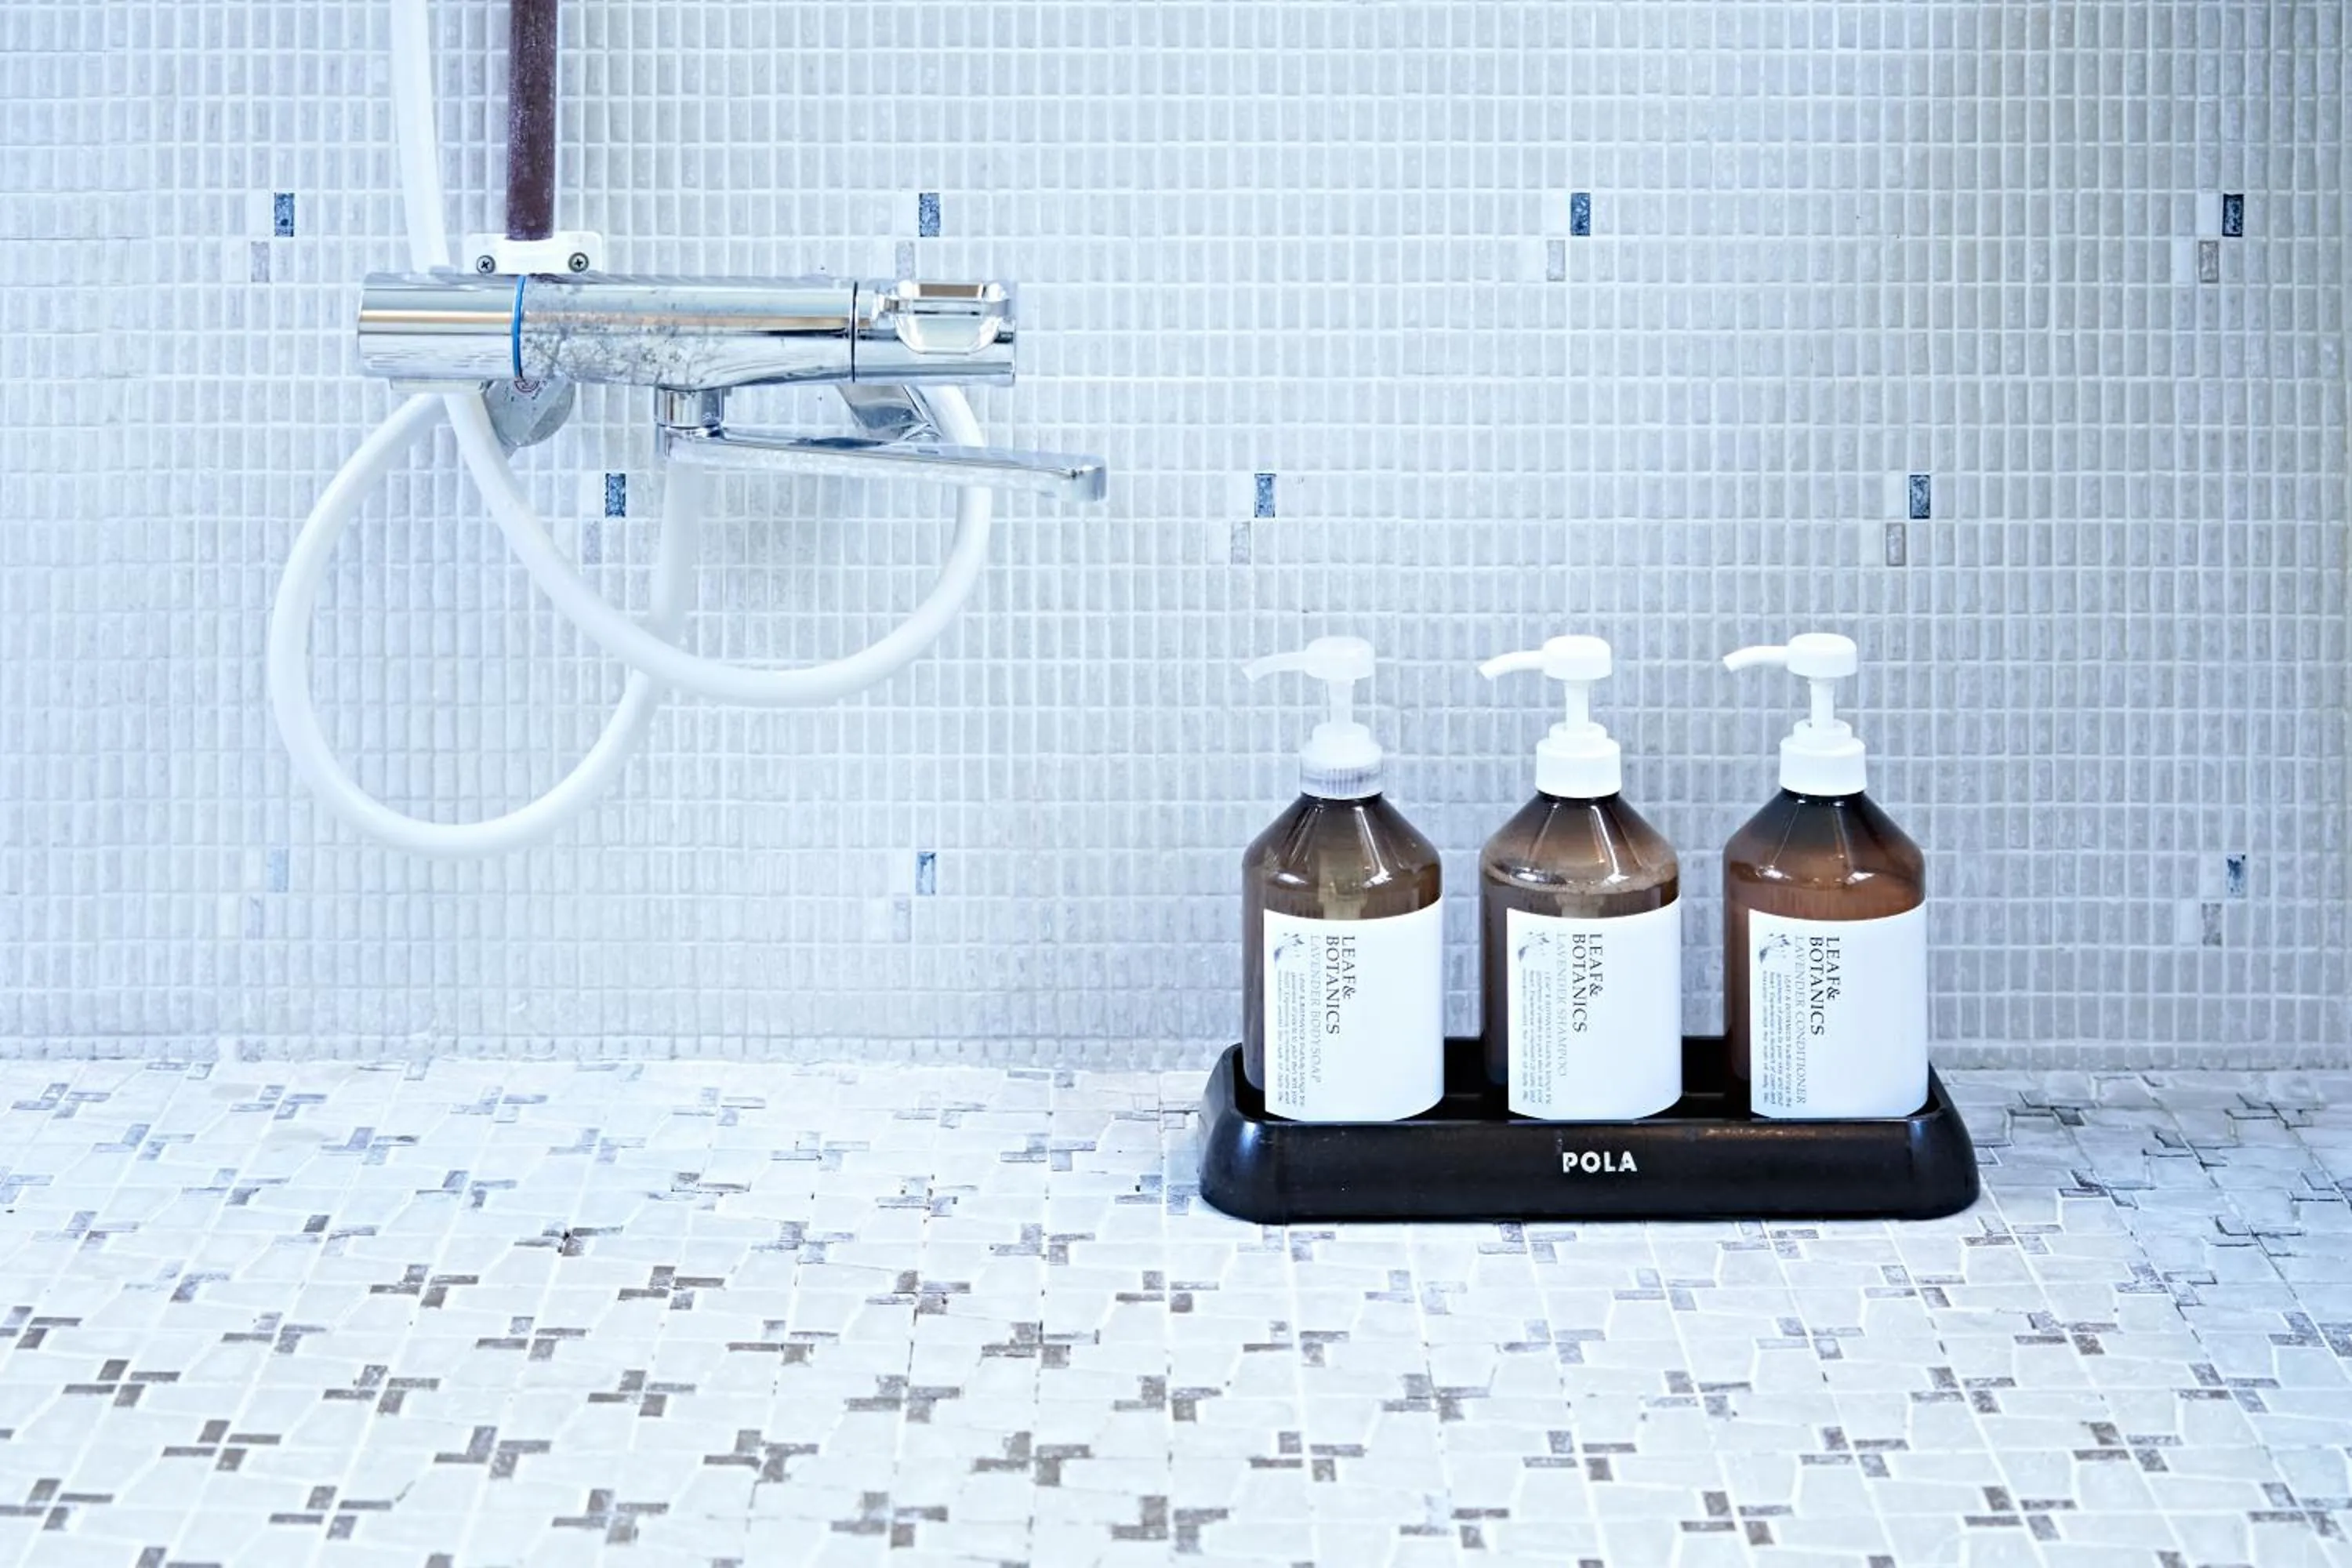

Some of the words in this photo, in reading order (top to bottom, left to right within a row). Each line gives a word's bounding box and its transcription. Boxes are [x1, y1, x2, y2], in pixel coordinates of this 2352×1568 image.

[1310, 935, 1320, 1006] LAVENDER
[1326, 935, 1340, 1035] BOTANICS
[1341, 935, 1356, 1000] LEAF&
[1556, 932, 1567, 1005] LAVENDER
[1572, 934, 1587, 1033] BOTANICS
[1589, 934, 1603, 996] LEAF&
[1795, 935, 1806, 1007] LAVENDER
[1809, 937, 1824, 1036] BOTANICS
[1826, 937, 1841, 1000] LEAF&
[1557, 1008, 1568, 1077] SHAMPOO
[1796, 1011, 1807, 1104] CONDITIONER
[1563, 1150, 1638, 1174] POLA
